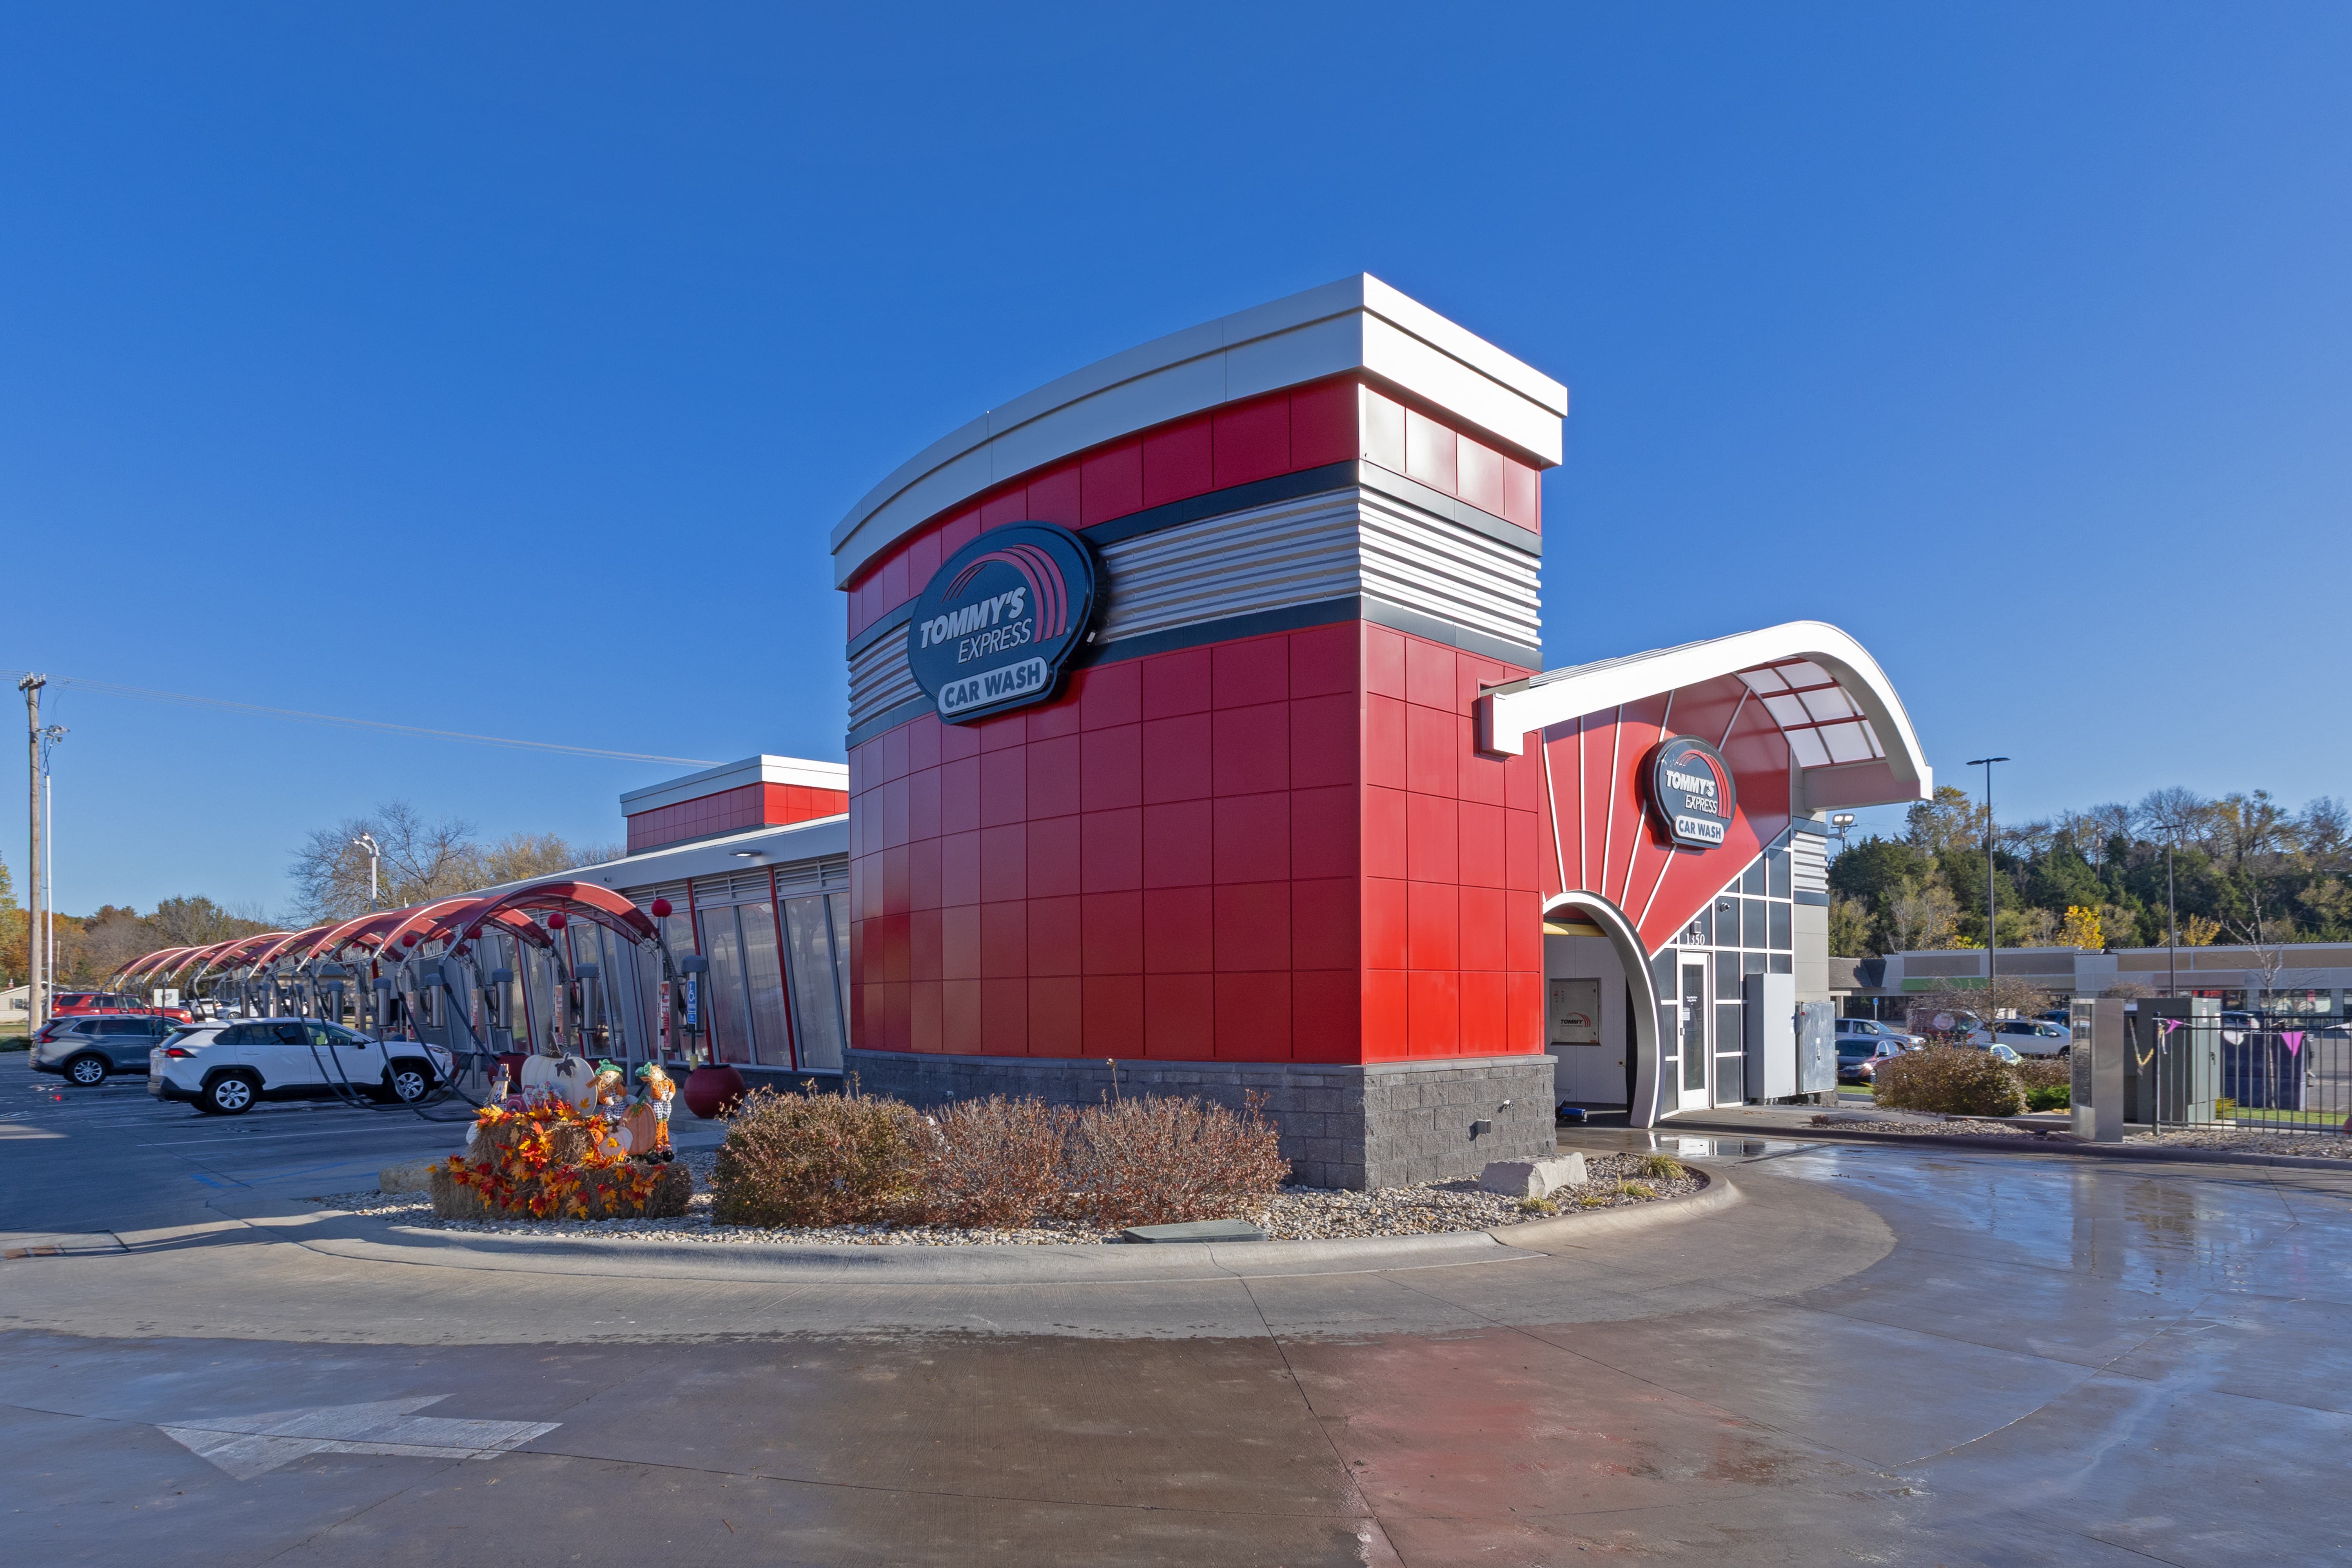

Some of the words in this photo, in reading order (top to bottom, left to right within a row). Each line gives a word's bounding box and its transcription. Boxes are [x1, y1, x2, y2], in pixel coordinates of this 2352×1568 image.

[920, 586, 1027, 649] TOMMY'S
[958, 617, 1033, 664] EXPRESS
[944, 681, 980, 708] CAR
[984, 662, 1040, 697] WASH
[1666, 770, 1715, 797] TOMMY'S
[1685, 794, 1717, 814] EXPRESS
[1679, 819, 1695, 835] CAR
[1698, 822, 1721, 839] WASH
[1686, 933, 1705, 946] 1350
